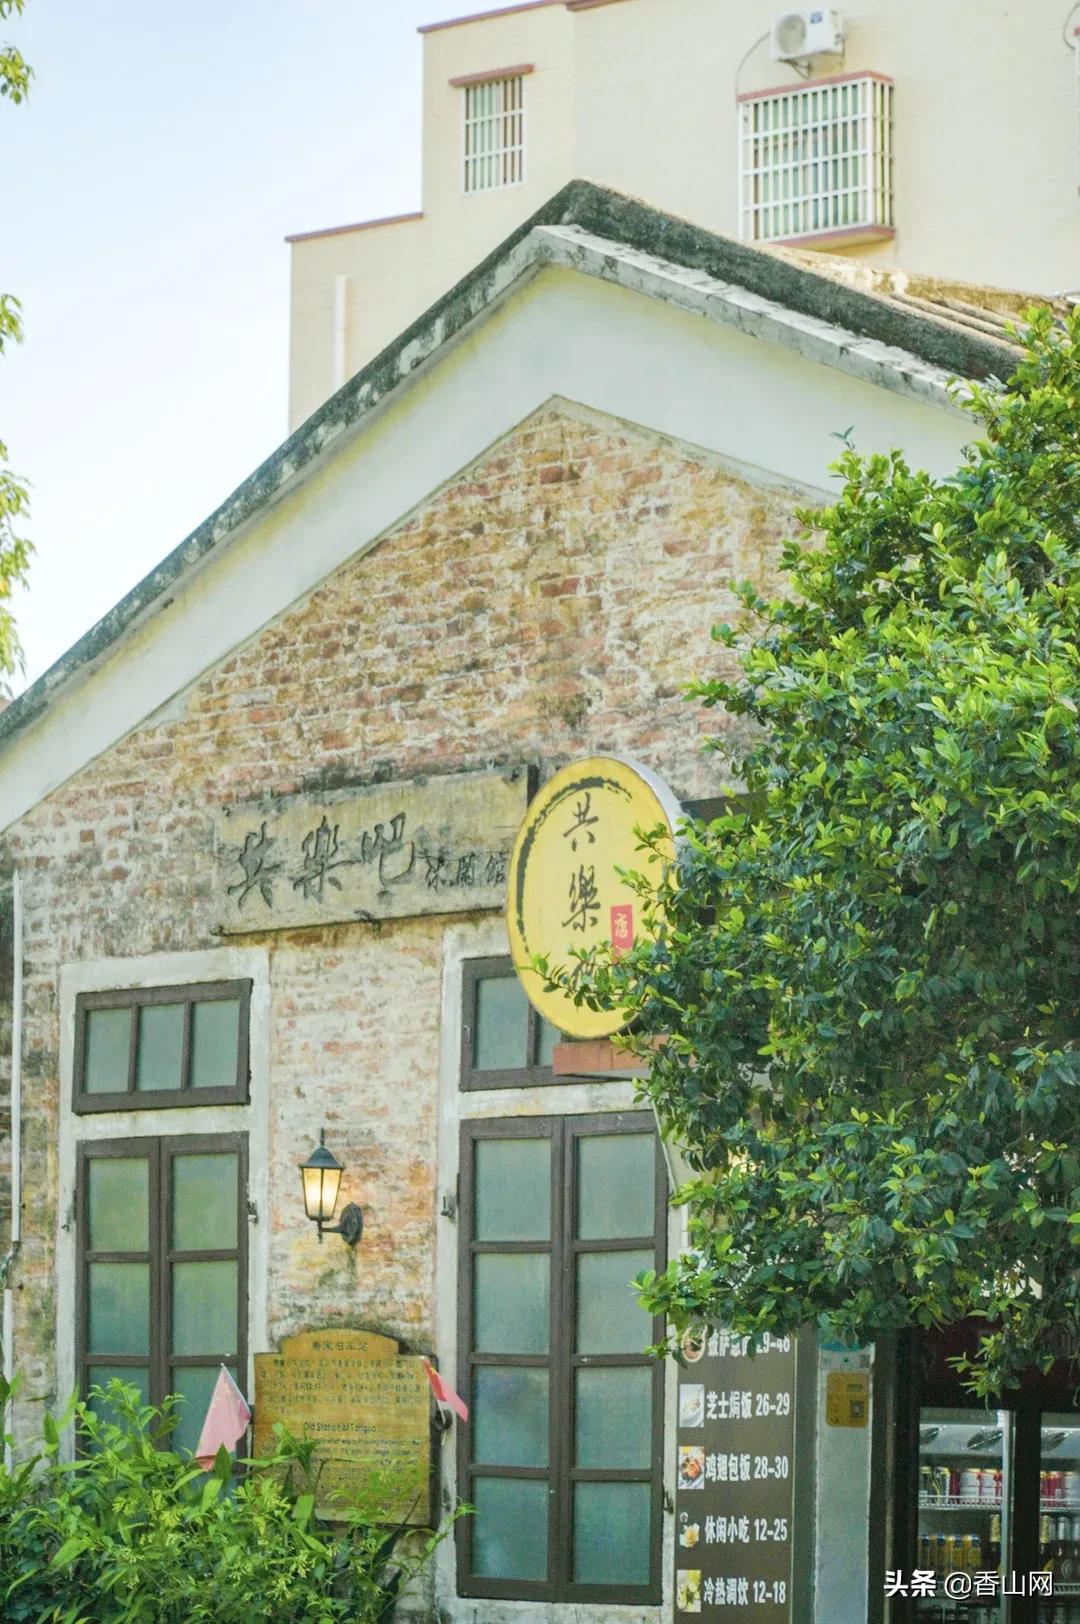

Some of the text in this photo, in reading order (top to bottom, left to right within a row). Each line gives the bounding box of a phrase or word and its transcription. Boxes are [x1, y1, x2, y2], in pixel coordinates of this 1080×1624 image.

[706, 1391, 791, 1419] 芝士焗饭 26-29
[705, 1452, 789, 1482] 鸡翅包饭 28-30
[704, 1515, 788, 1544] 休闲小吃 12-25
[703, 1577, 787, 1605] 冷热调饮 12-18
